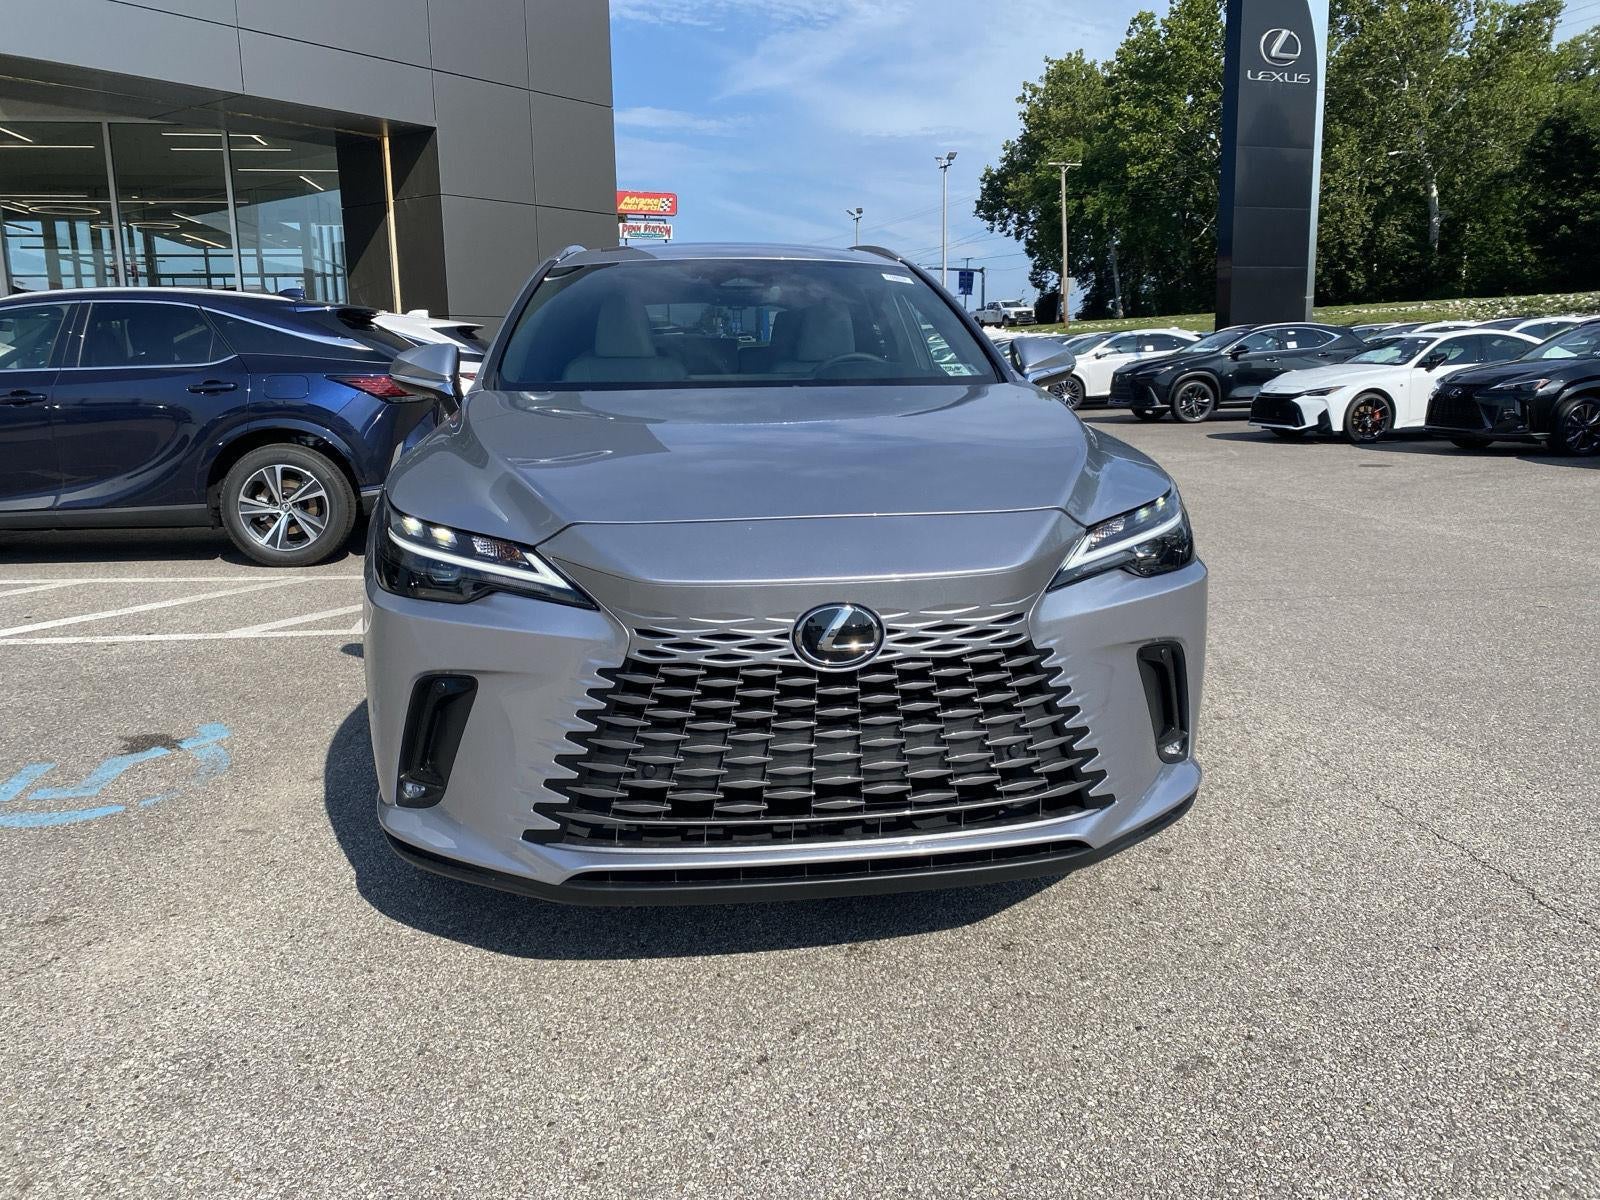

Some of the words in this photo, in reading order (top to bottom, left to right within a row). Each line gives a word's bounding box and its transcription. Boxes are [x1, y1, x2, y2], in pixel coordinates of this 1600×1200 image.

[1247, 69, 1311, 84] LEXUS
[622, 196, 660, 205] Advance
[638, 203, 658, 211] Parts
[643, 224, 672, 238] STATION
